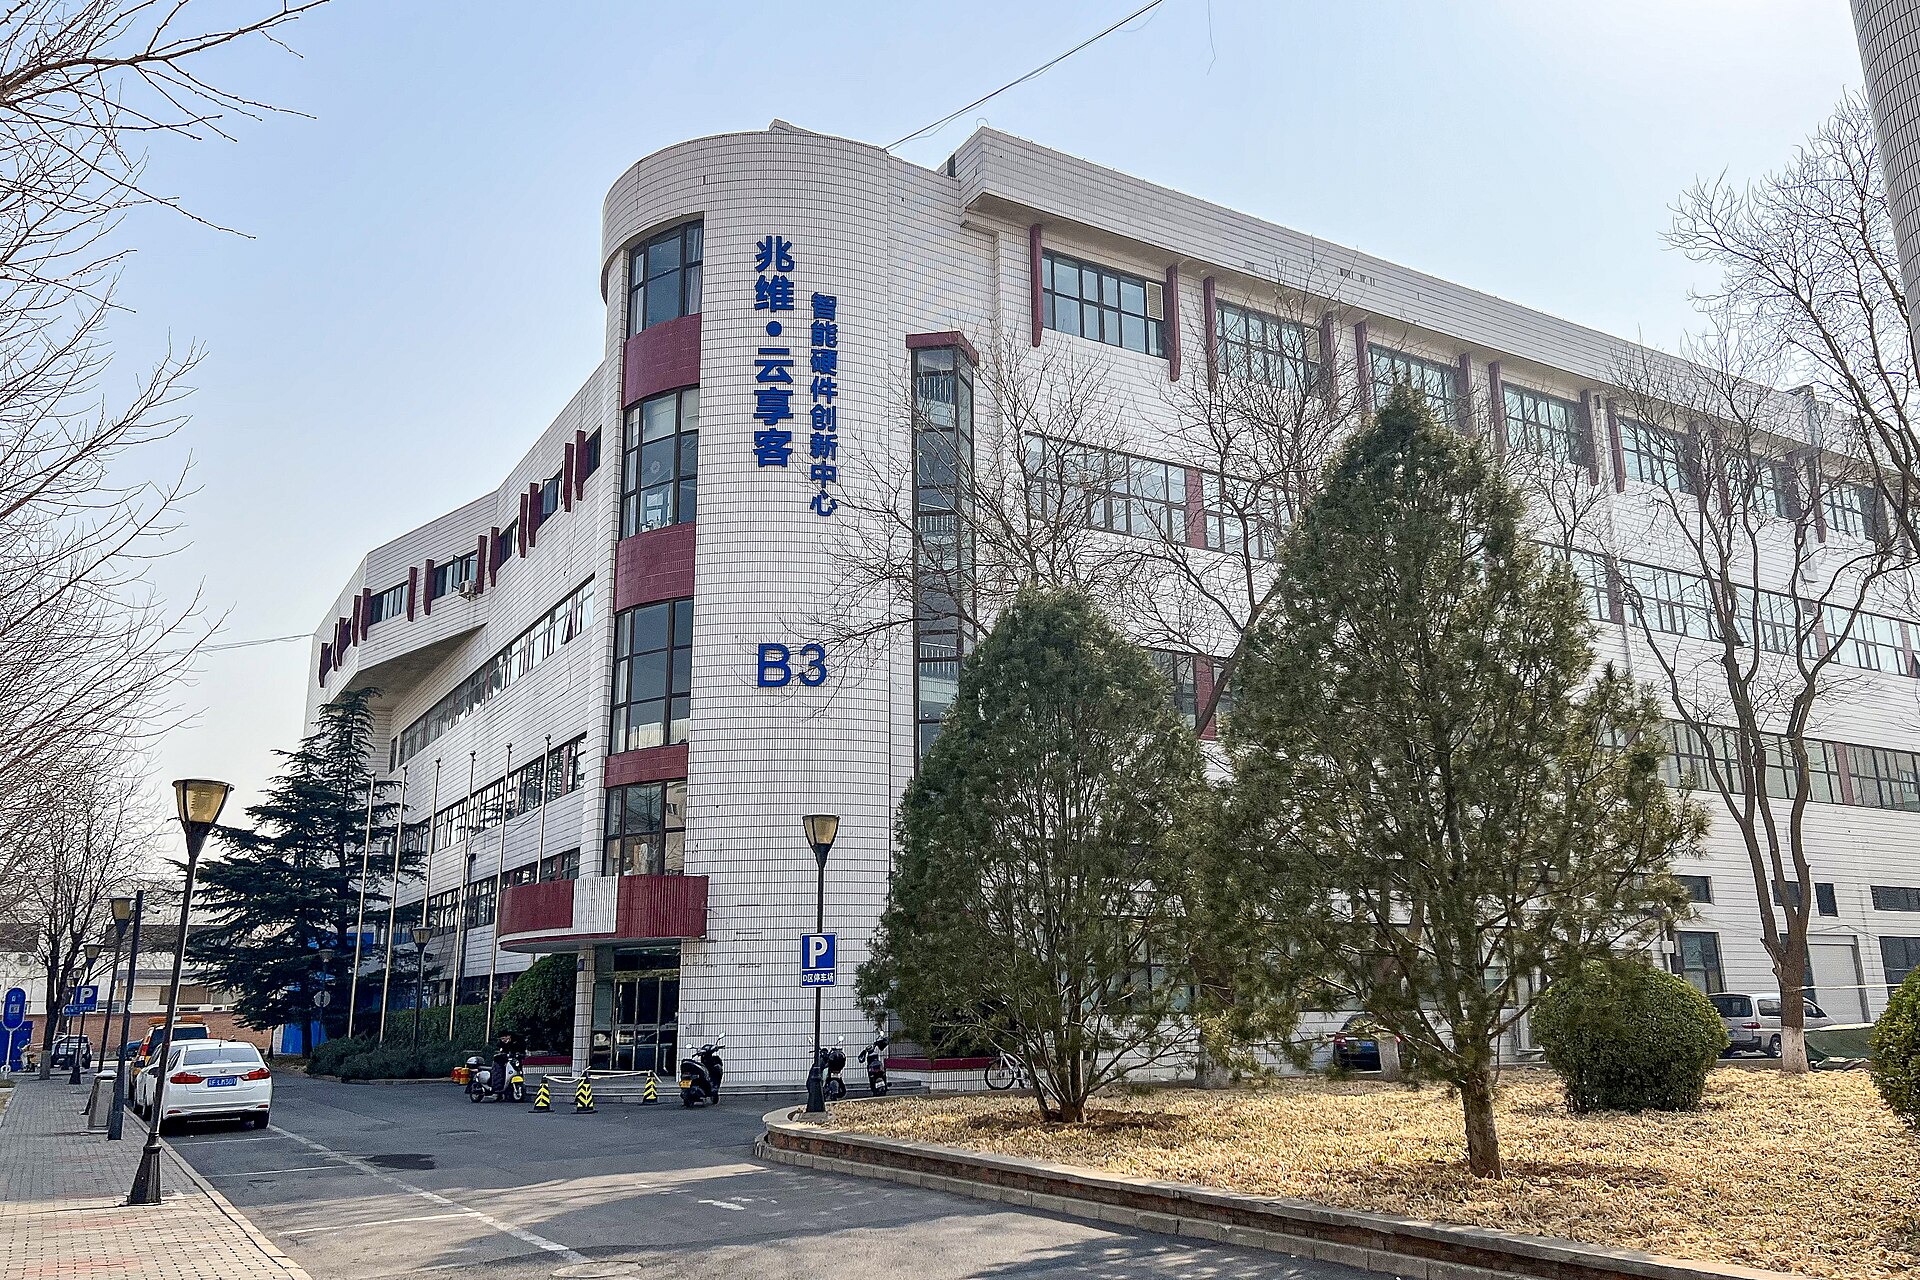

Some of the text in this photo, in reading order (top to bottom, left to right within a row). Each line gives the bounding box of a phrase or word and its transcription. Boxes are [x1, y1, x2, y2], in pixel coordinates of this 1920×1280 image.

[810, 292, 838, 517] 智能硬件创新中心
[758, 643, 827, 687] B3
[809, 937, 828, 967] P
[803, 973, 834, 982] D区停车场
[80, 988, 94, 1003] P
